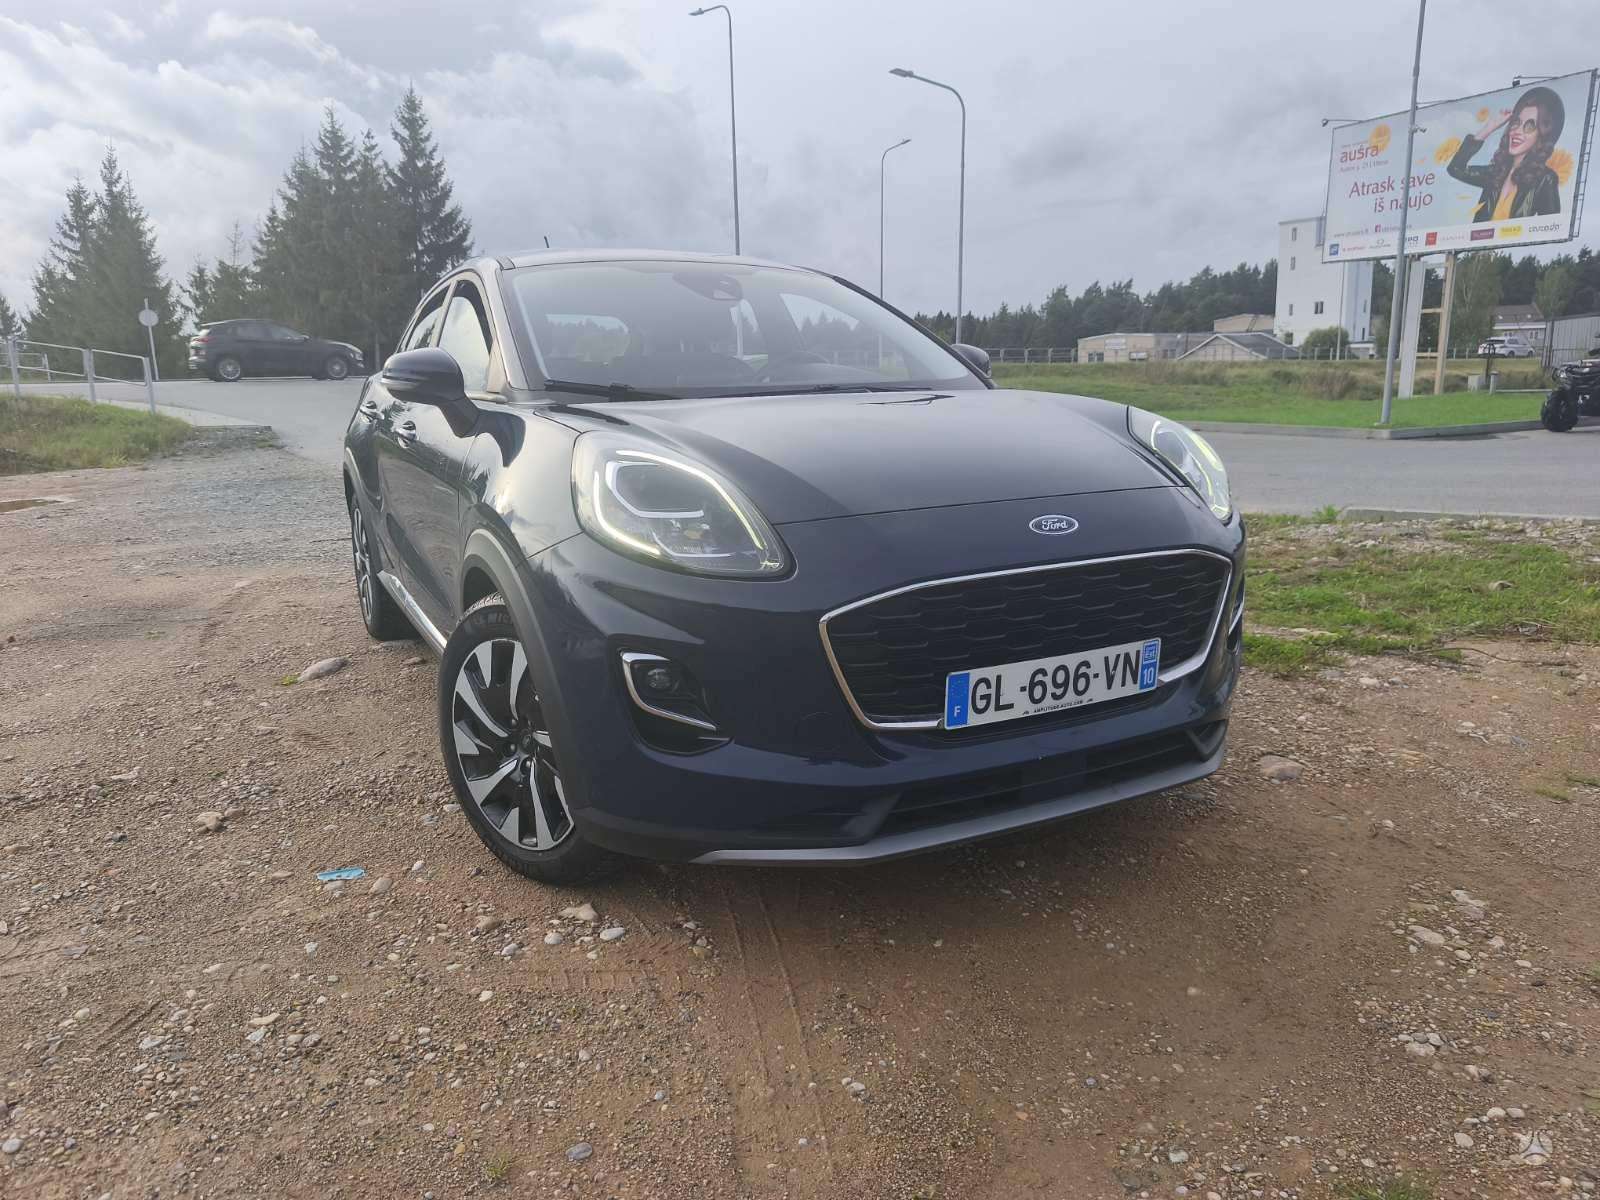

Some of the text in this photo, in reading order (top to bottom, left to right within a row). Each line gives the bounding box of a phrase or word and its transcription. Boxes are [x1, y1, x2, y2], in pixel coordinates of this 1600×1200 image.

[1349, 175, 1395, 198] Atrask
[1374, 196, 1385, 213] iš
[1041, 518, 1068, 531] Ford
[971, 650, 1140, 715] GL-696-VN
[1143, 667, 1154, 685] 10
[953, 705, 961, 718] F
